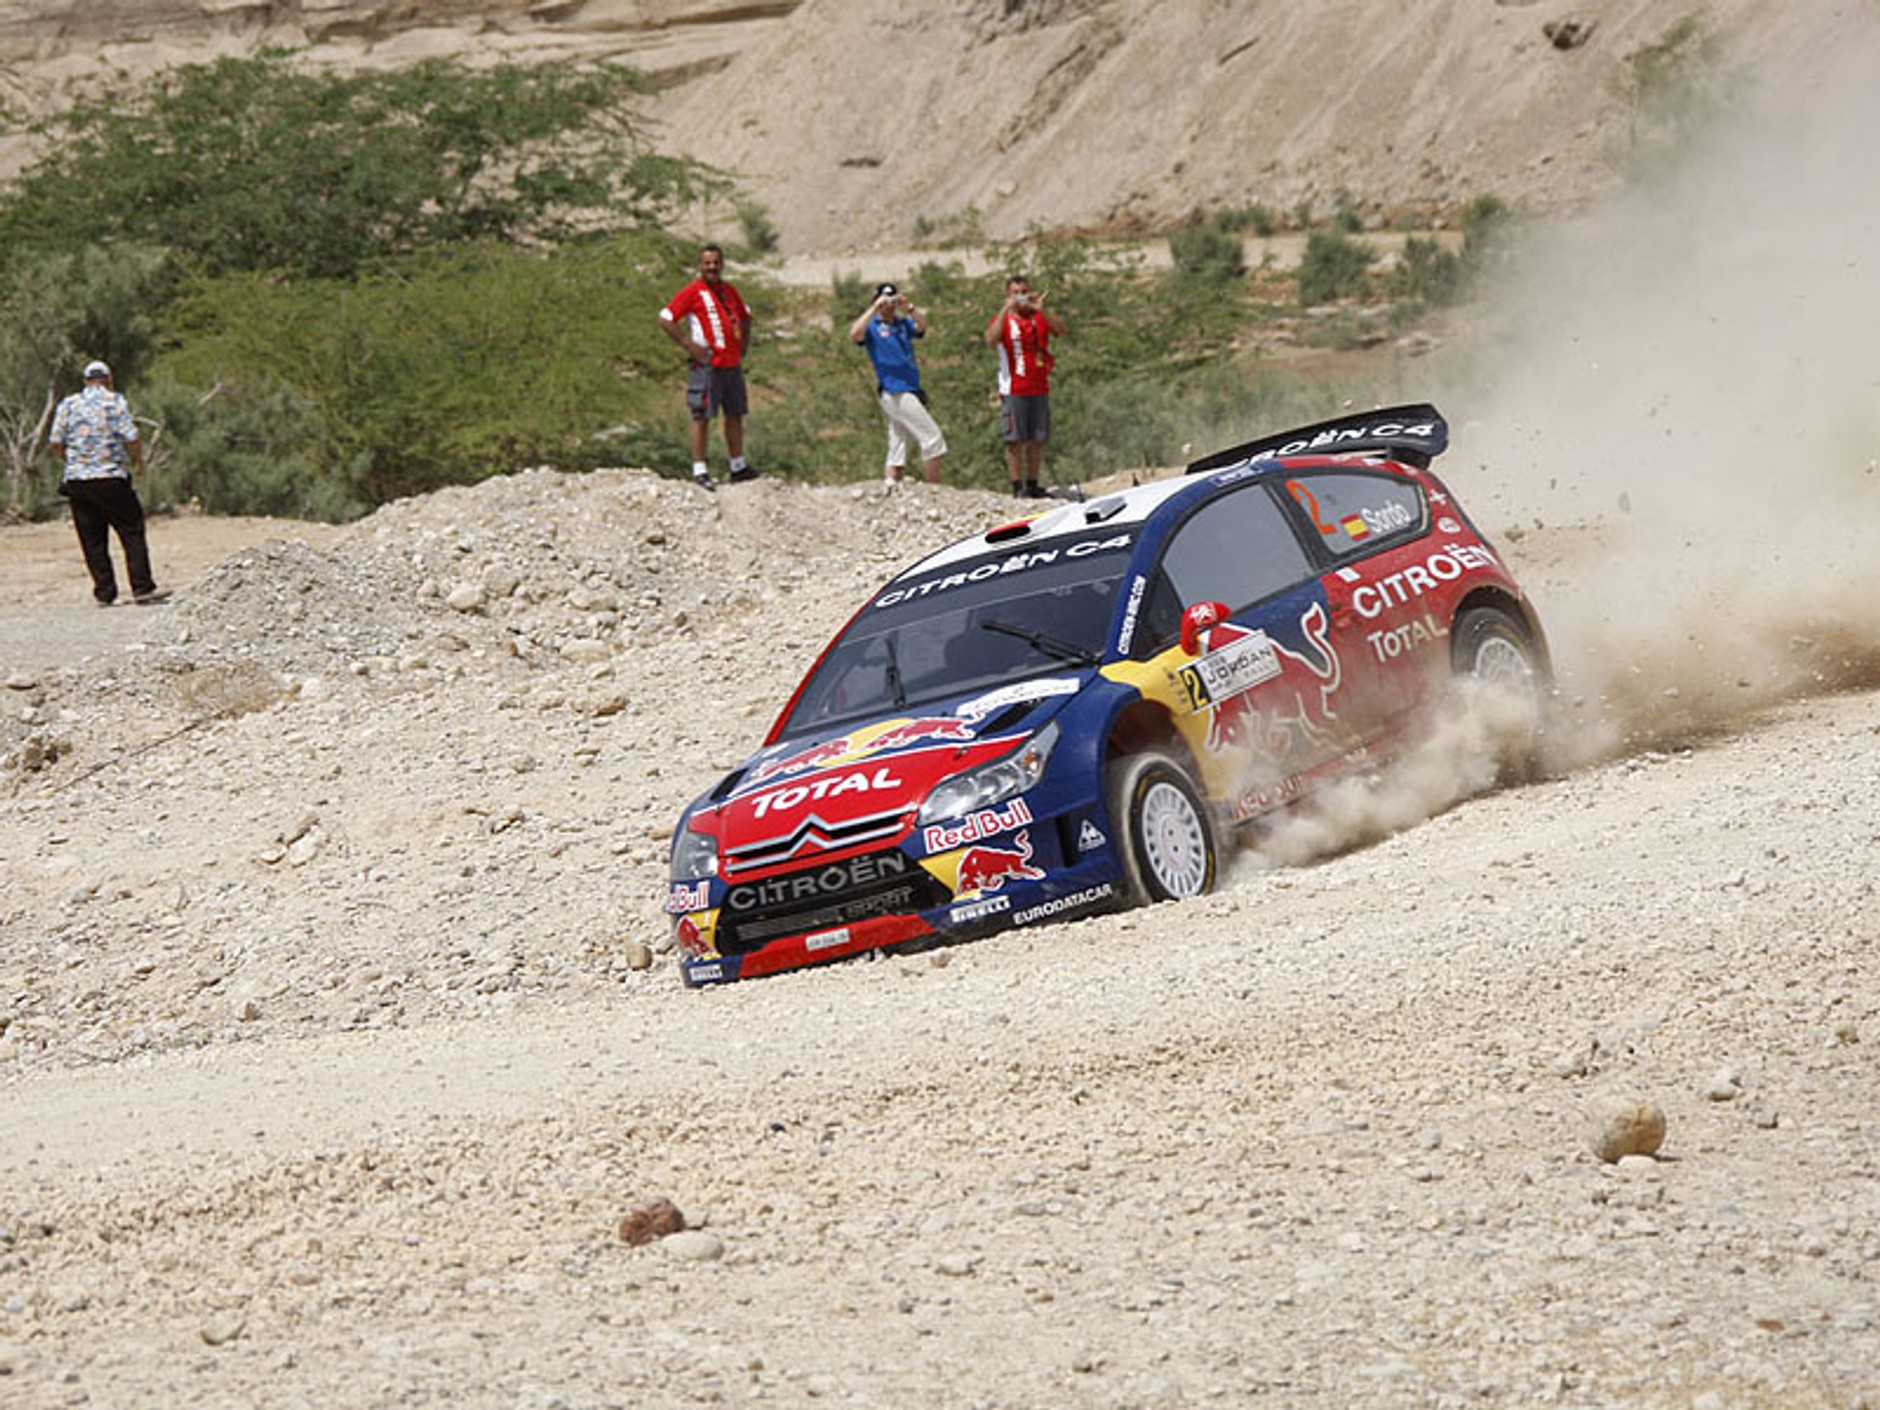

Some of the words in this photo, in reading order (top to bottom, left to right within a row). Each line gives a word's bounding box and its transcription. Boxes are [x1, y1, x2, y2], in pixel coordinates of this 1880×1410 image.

[1371, 422, 1436, 437] C4
[1285, 479, 1337, 535] 2
[875, 550, 1058, 607] CITROËN
[1066, 534, 1132, 556] C4
[1352, 543, 1498, 618] CITROËN
[1367, 613, 1449, 663] TOTAL
[1184, 669, 1208, 707] 2
[751, 769, 901, 818] TOTAL
[925, 815, 979, 852] Red
[980, 798, 1032, 834] Bull
[729, 853, 906, 909] CITROËN
[1013, 883, 1113, 924] EURODATACAR
